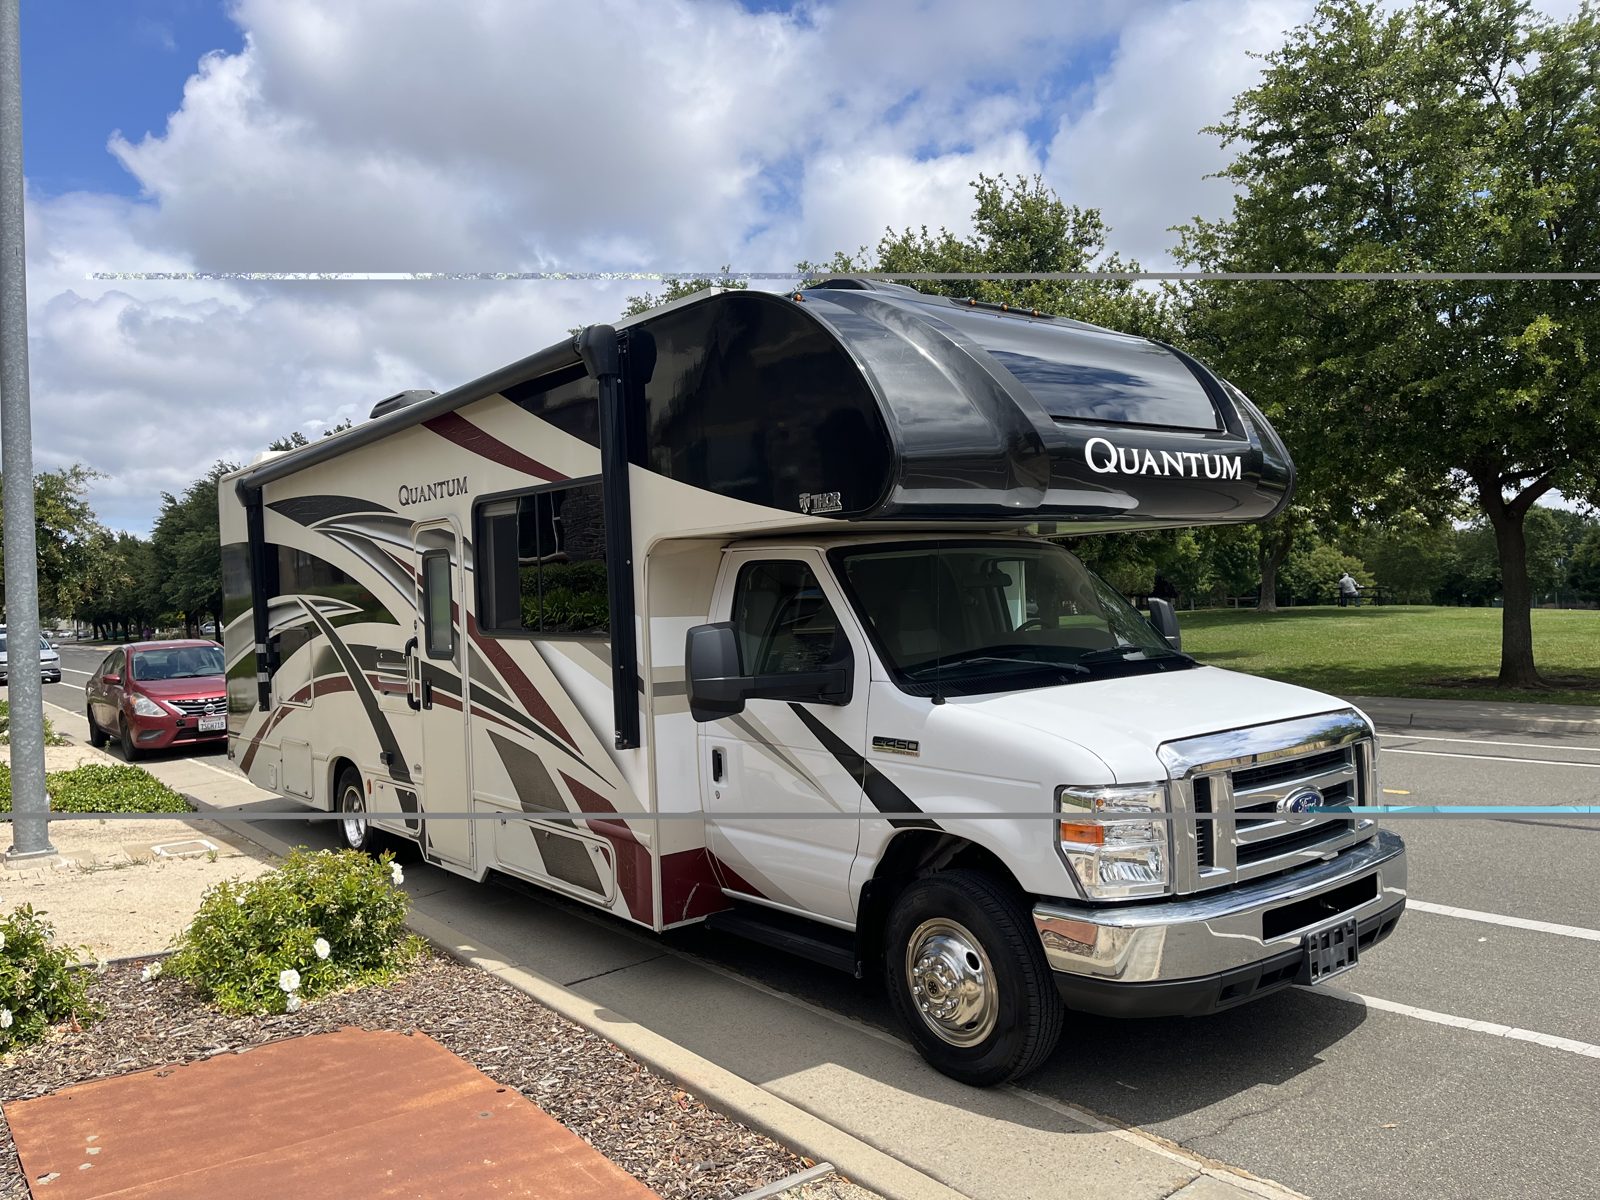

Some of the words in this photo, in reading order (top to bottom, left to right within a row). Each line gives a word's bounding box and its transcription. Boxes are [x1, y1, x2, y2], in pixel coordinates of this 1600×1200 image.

[1084, 437, 1242, 480] QUANTUM
[398, 476, 468, 506] QUANTUM
[810, 491, 842, 509] THOR
